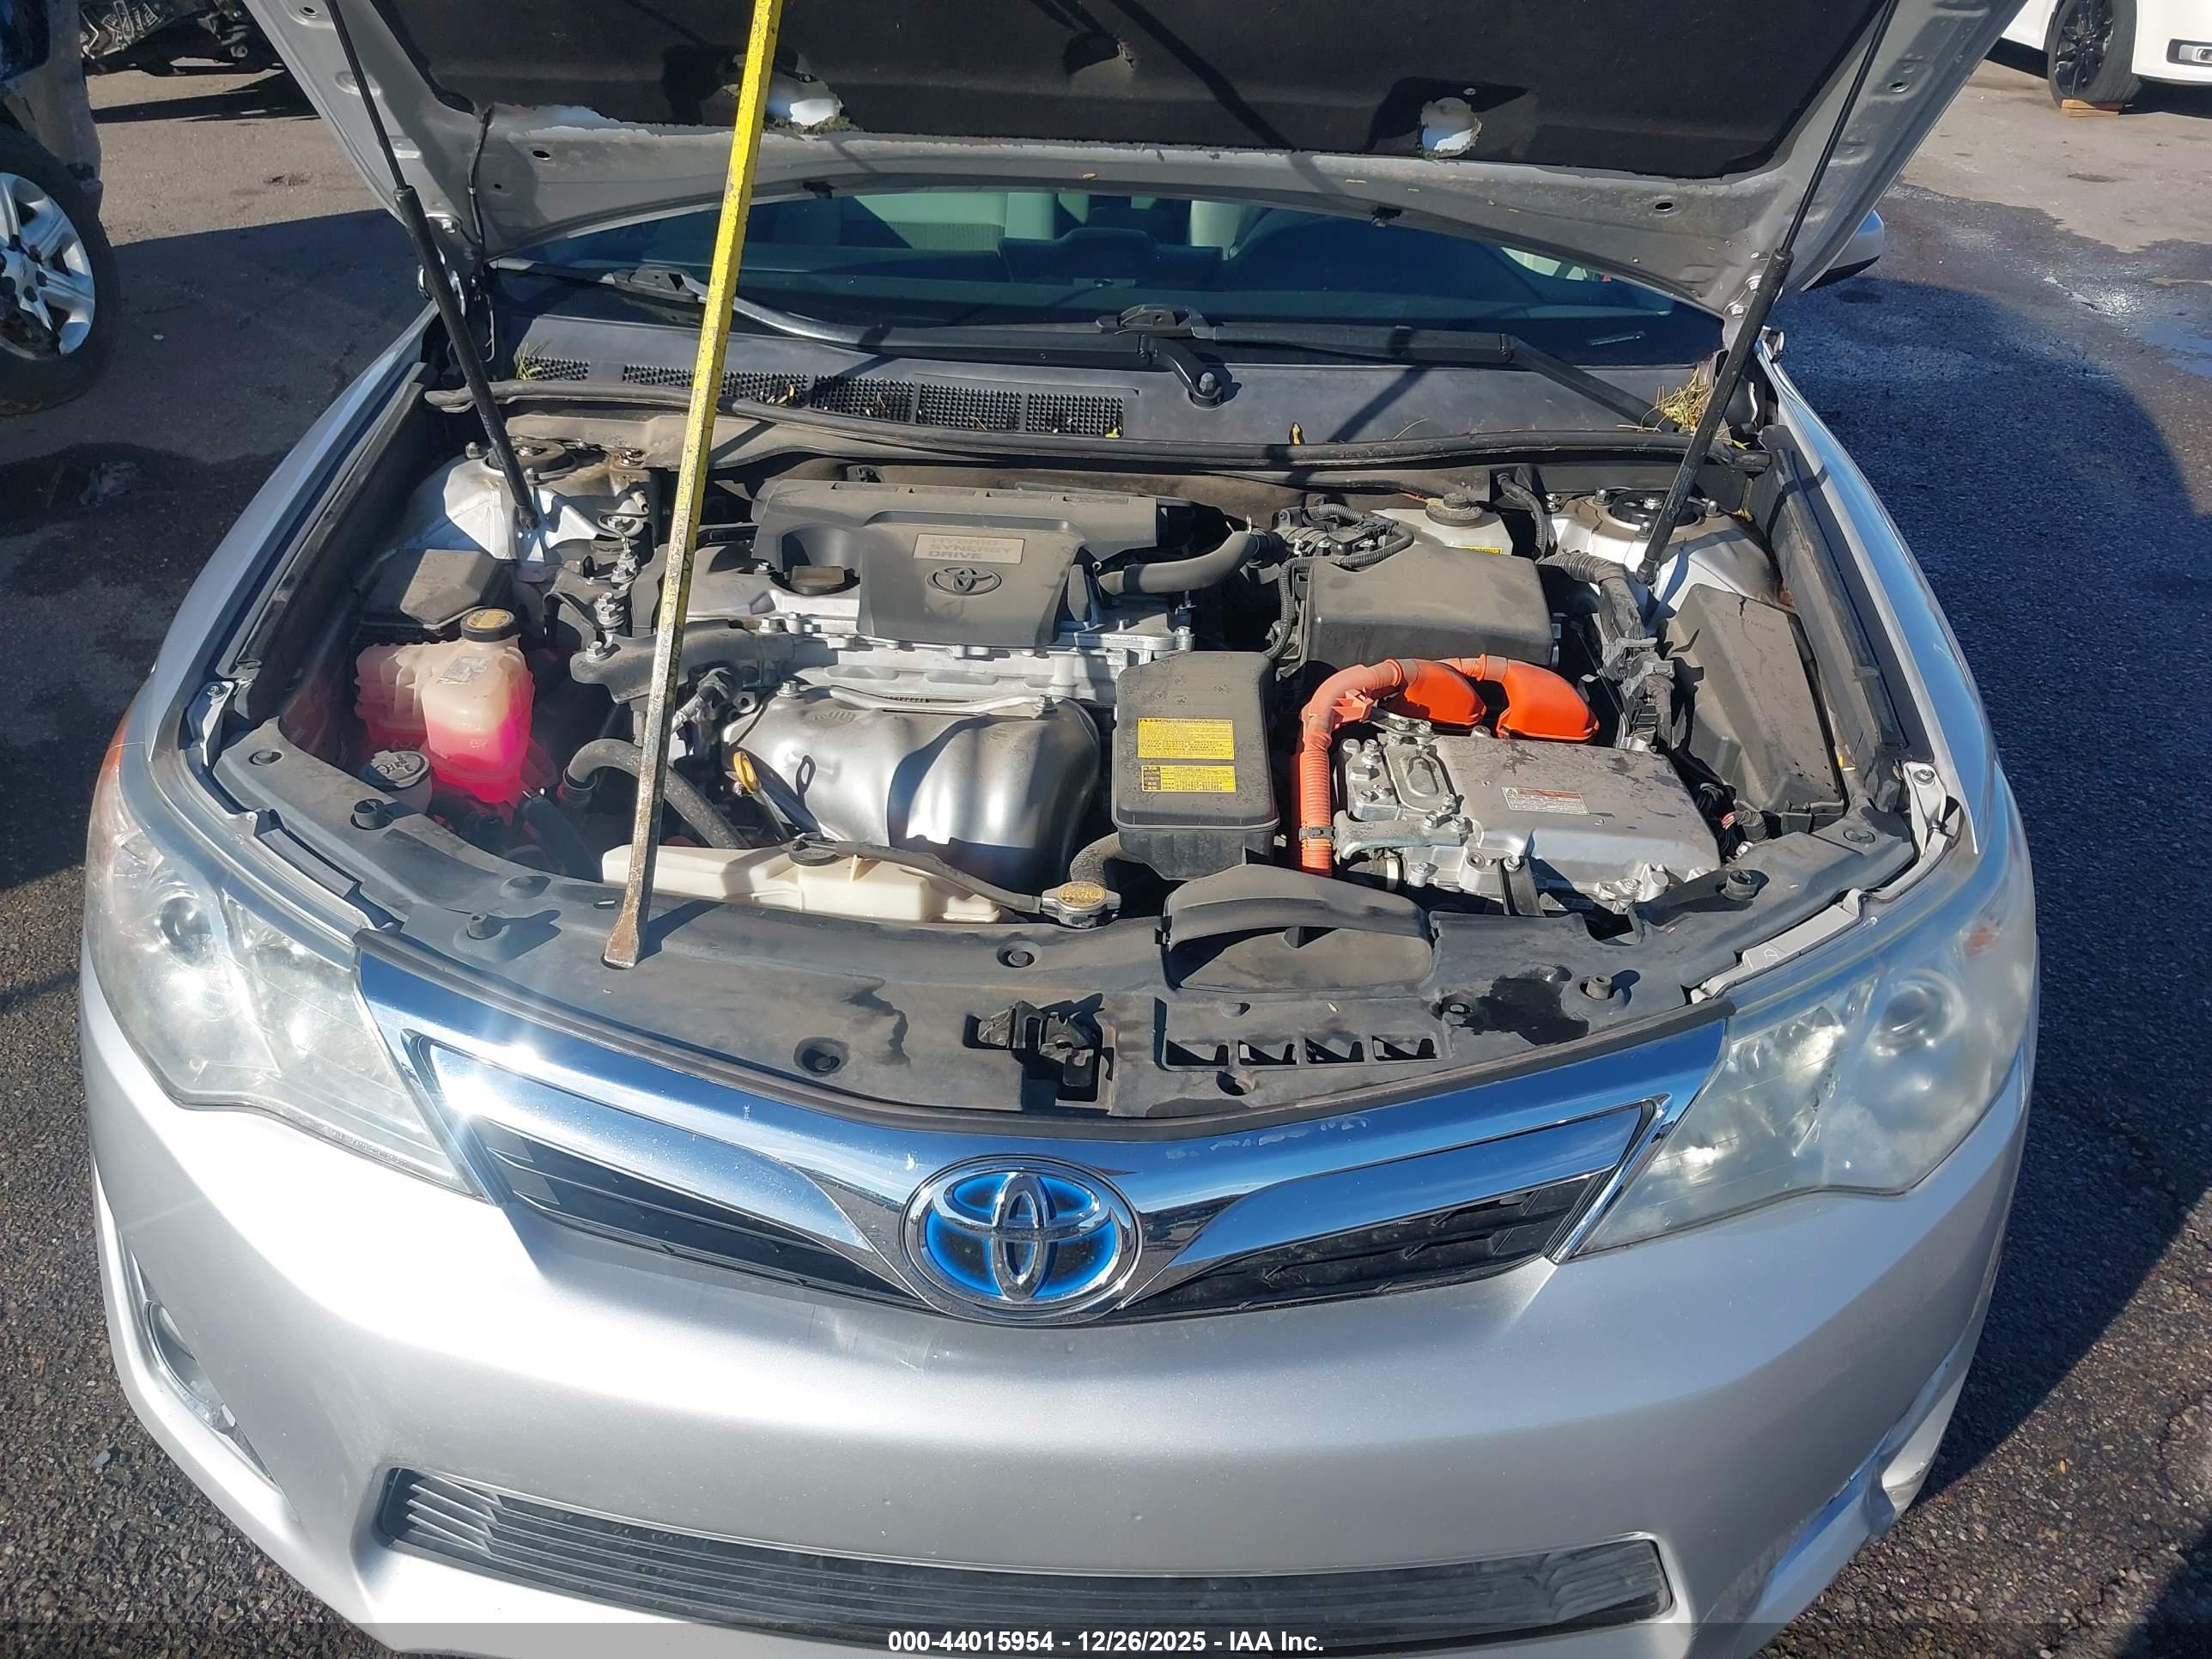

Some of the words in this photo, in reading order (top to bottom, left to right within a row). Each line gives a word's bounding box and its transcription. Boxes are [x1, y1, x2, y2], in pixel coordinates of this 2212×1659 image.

[932, 537, 998, 546] HYBRID
[929, 544, 1012, 554] SYNERGY
[928, 550, 981, 560] DRIVE
